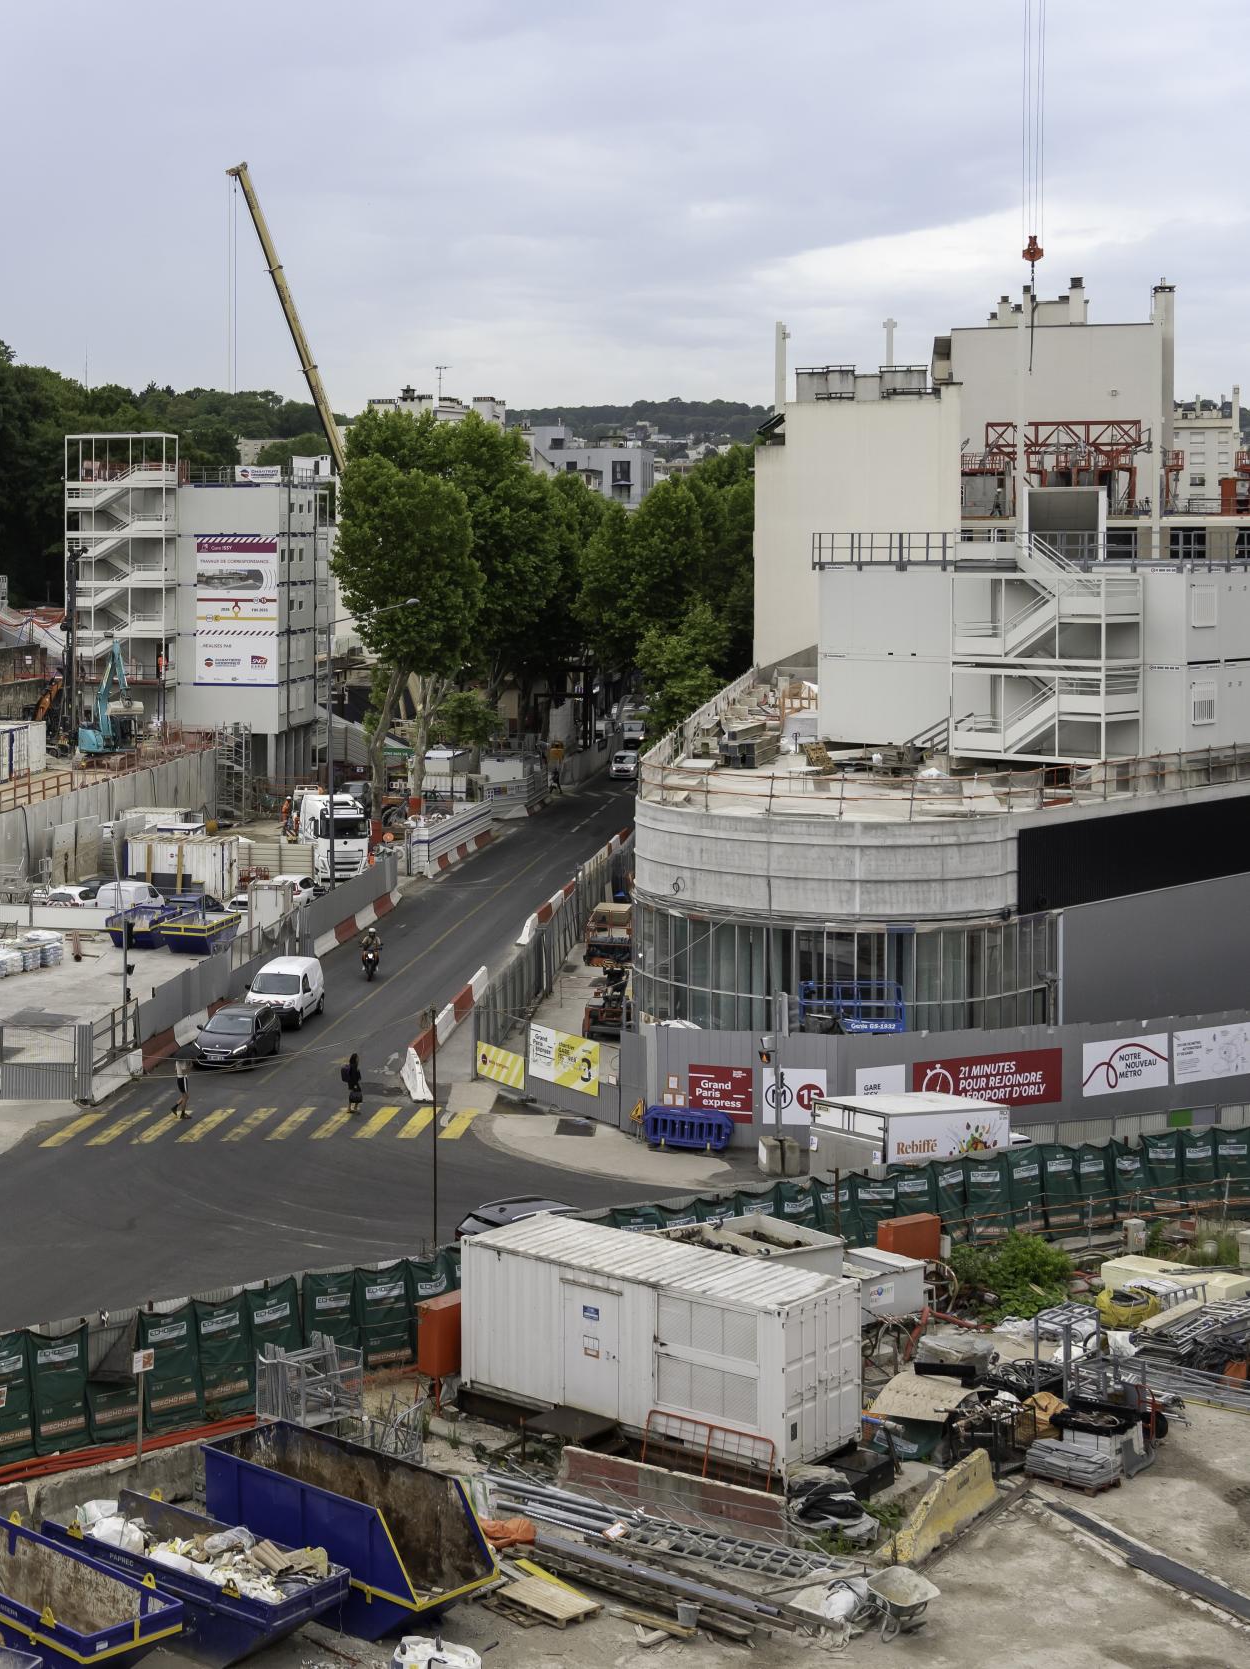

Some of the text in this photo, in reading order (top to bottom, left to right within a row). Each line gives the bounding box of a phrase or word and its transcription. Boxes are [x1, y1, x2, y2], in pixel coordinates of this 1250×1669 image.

[533, 1039, 543, 1047] Paris
[535, 1034, 547, 1042] Grand
[1119, 1052, 1142, 1062] NOTRE
[1125, 1059, 1157, 1069] NOUVEAU
[580, 1057, 591, 1082] 3
[959, 1061, 1016, 1078] 21 MINUTES
[1119, 1069, 1142, 1079] MÉTRO
[701, 1080, 731, 1090] Grand
[959, 1071, 1043, 1091] POUR REJOINDRE
[864, 1083, 882, 1091] GARE
[1013, 1084, 1046, 1097] D'ORLY
[695, 1088, 721, 1098] Paris
[702, 1099, 741, 1108] express
[896, 1139, 938, 1155] Rebiffé
